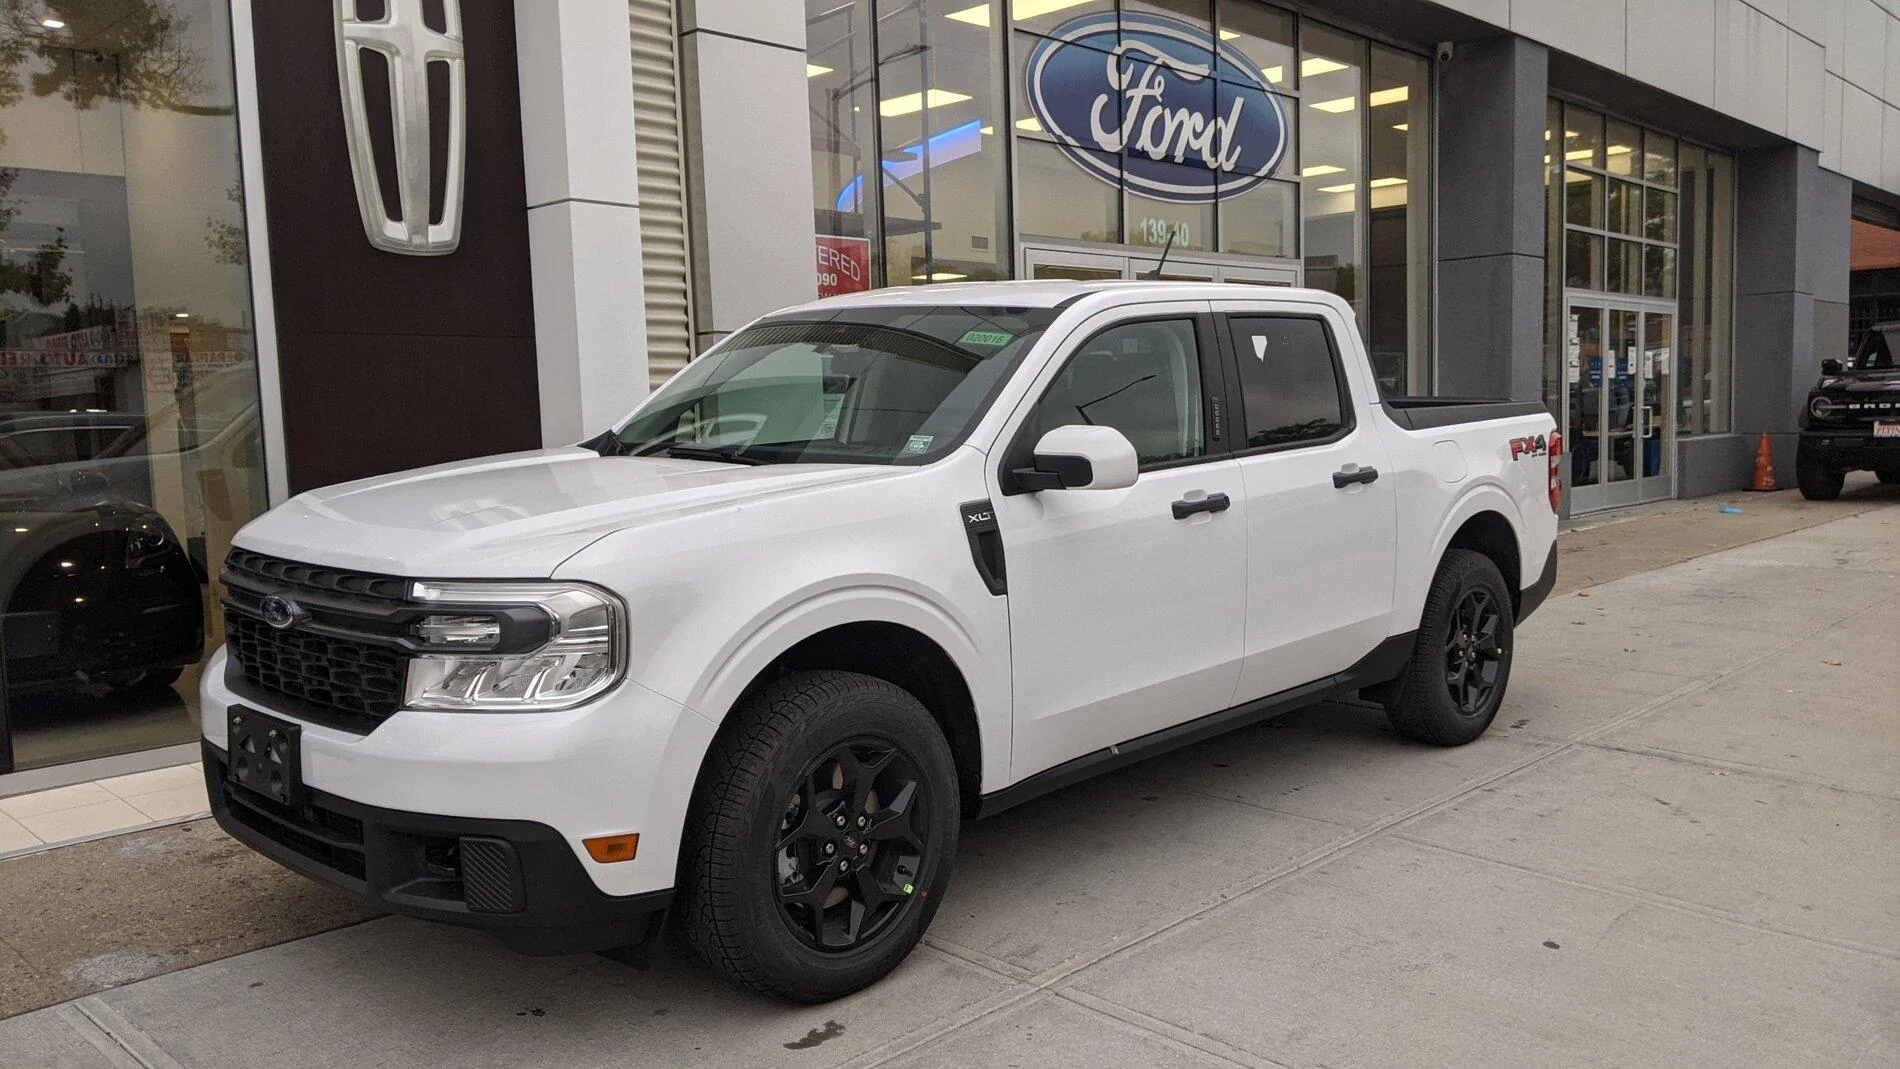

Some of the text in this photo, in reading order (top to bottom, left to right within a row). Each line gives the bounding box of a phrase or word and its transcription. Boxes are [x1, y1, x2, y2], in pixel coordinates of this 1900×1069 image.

[1090, 39, 1244, 172] Ford
[816, 245, 861, 282] ERED
[966, 331, 1006, 344] 020016
[1509, 434, 1547, 461] FX4
[967, 512, 991, 523] XLT
